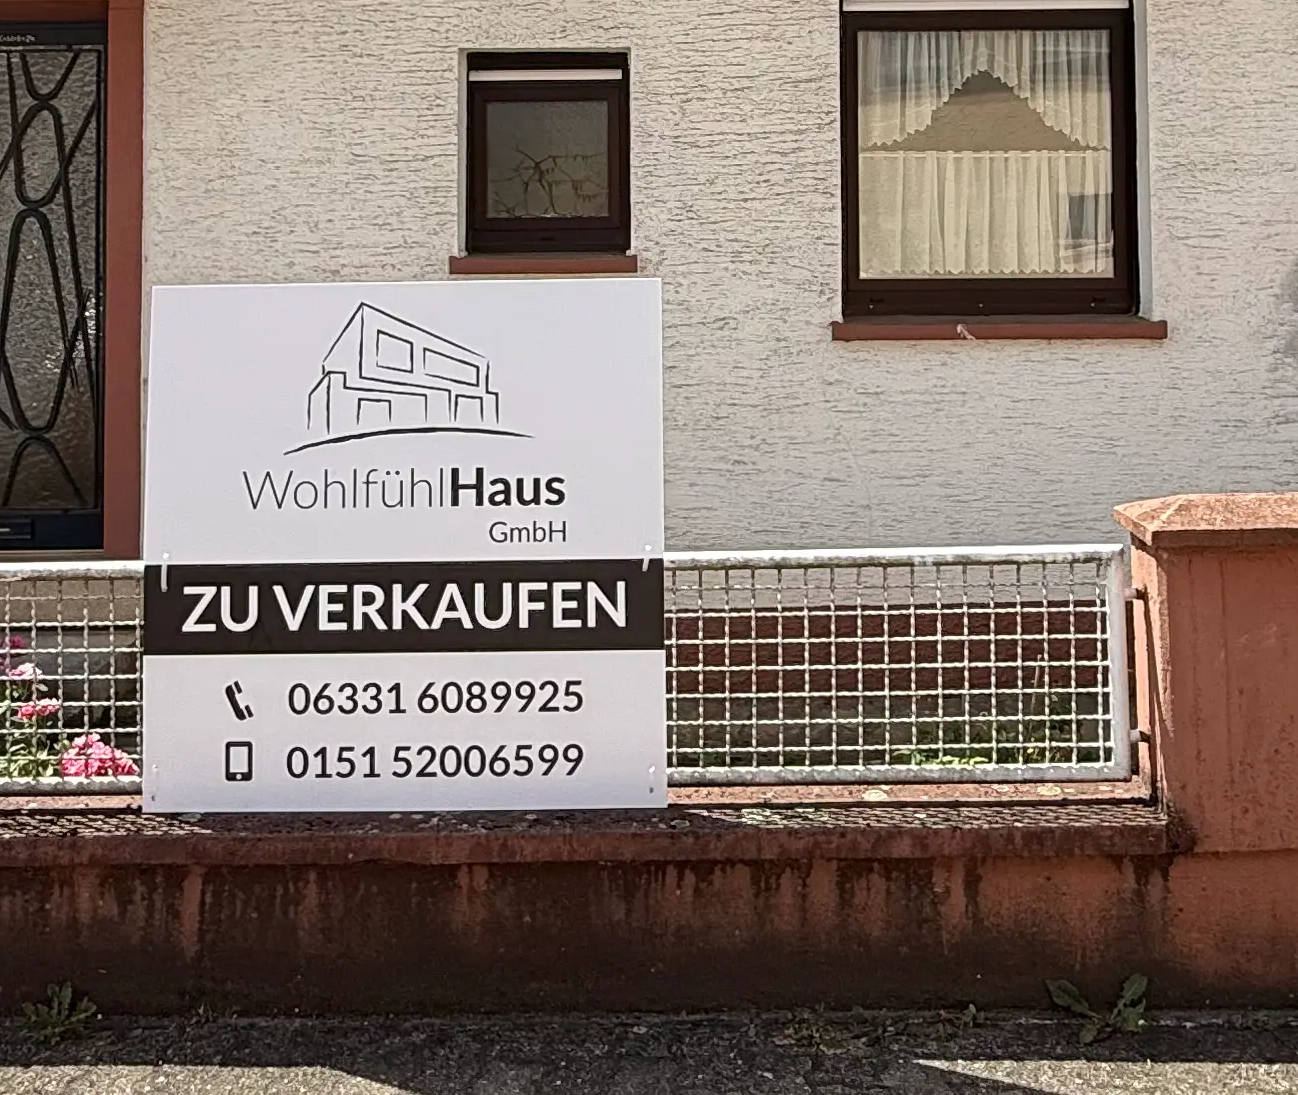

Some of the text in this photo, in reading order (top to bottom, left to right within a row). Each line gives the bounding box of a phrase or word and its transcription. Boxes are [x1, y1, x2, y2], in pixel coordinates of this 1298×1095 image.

[242, 466, 566, 510] WohlfühlHaus
[489, 520, 567, 543] GmbH
[181, 580, 627, 633] ZU VERKAUFEN
[287, 679, 584, 715] 06331 6089925
[286, 743, 584, 779] 0151 52006599
